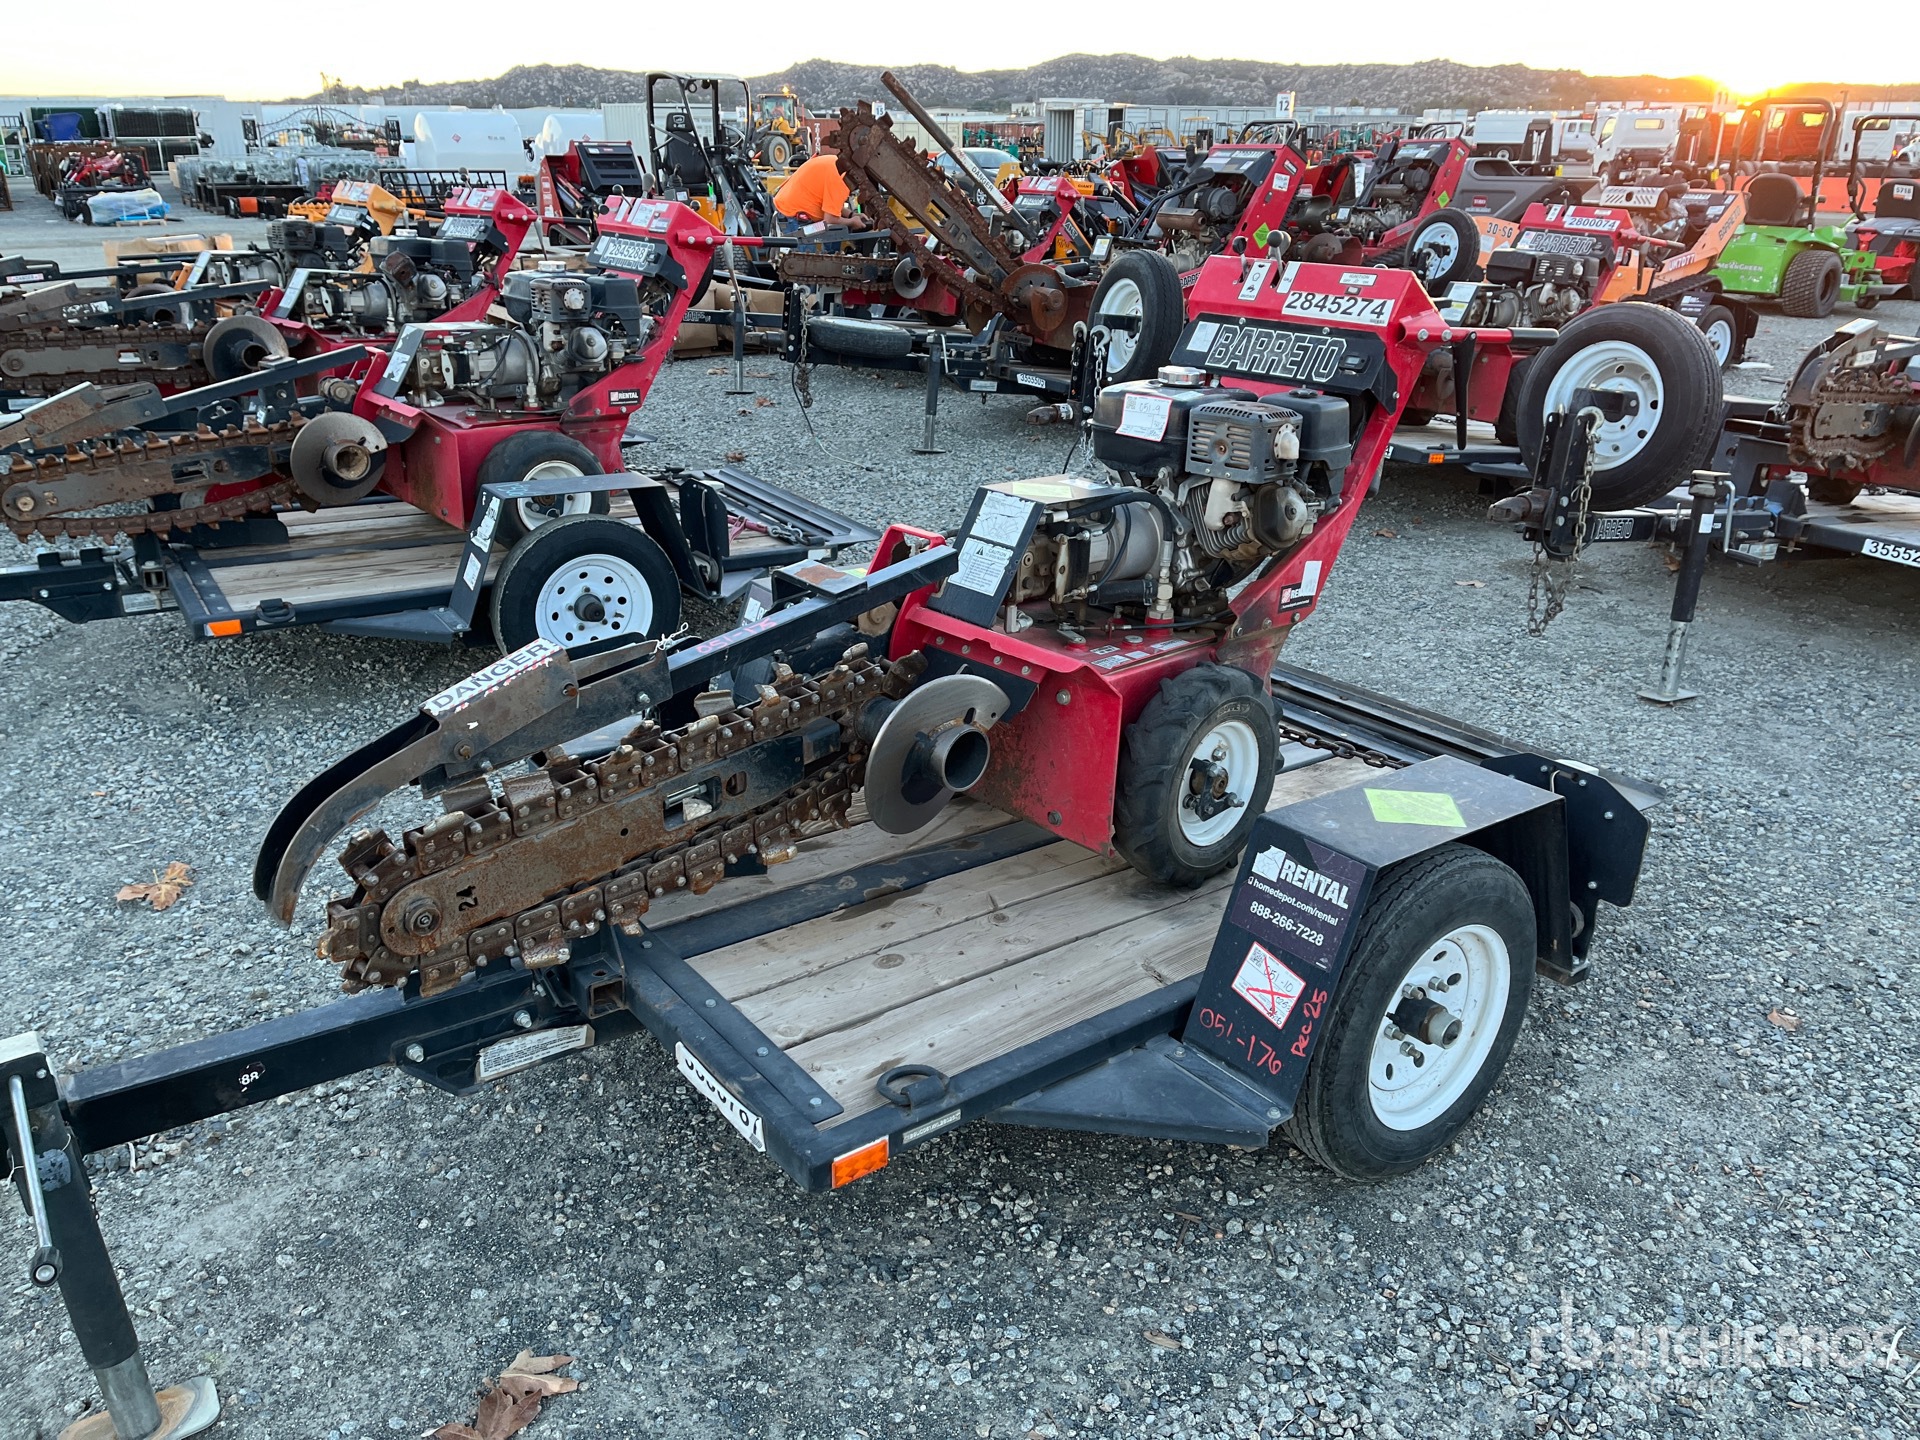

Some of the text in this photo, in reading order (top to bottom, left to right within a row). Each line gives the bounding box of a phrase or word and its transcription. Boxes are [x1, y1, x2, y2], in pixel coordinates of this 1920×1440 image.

[876, 107, 884, 115] 15
[1279, 100, 1290, 111] 12
[971, 166, 994, 192] DANGER
[1487, 222, 1513, 239] 30-SG
[1569, 217, 1616, 229] 2800074
[609, 243, 646, 260] 2845288
[1530, 232, 1597, 256] BARRETO
[1285, 291, 1388, 319] 2845274
[1205, 324, 1348, 383] BARRETO
[988, 548, 1007, 557] CAUTION
[432, 643, 549, 709] DANGER
[1280, 859, 1349, 910] RENTAL
[456, 885, 478, 911] 24
[1253, 879, 1339, 926] homedepot.com/rental
[1250, 901, 1324, 947] 888-266-7228
[1303, 987, 1328, 1019] 25
